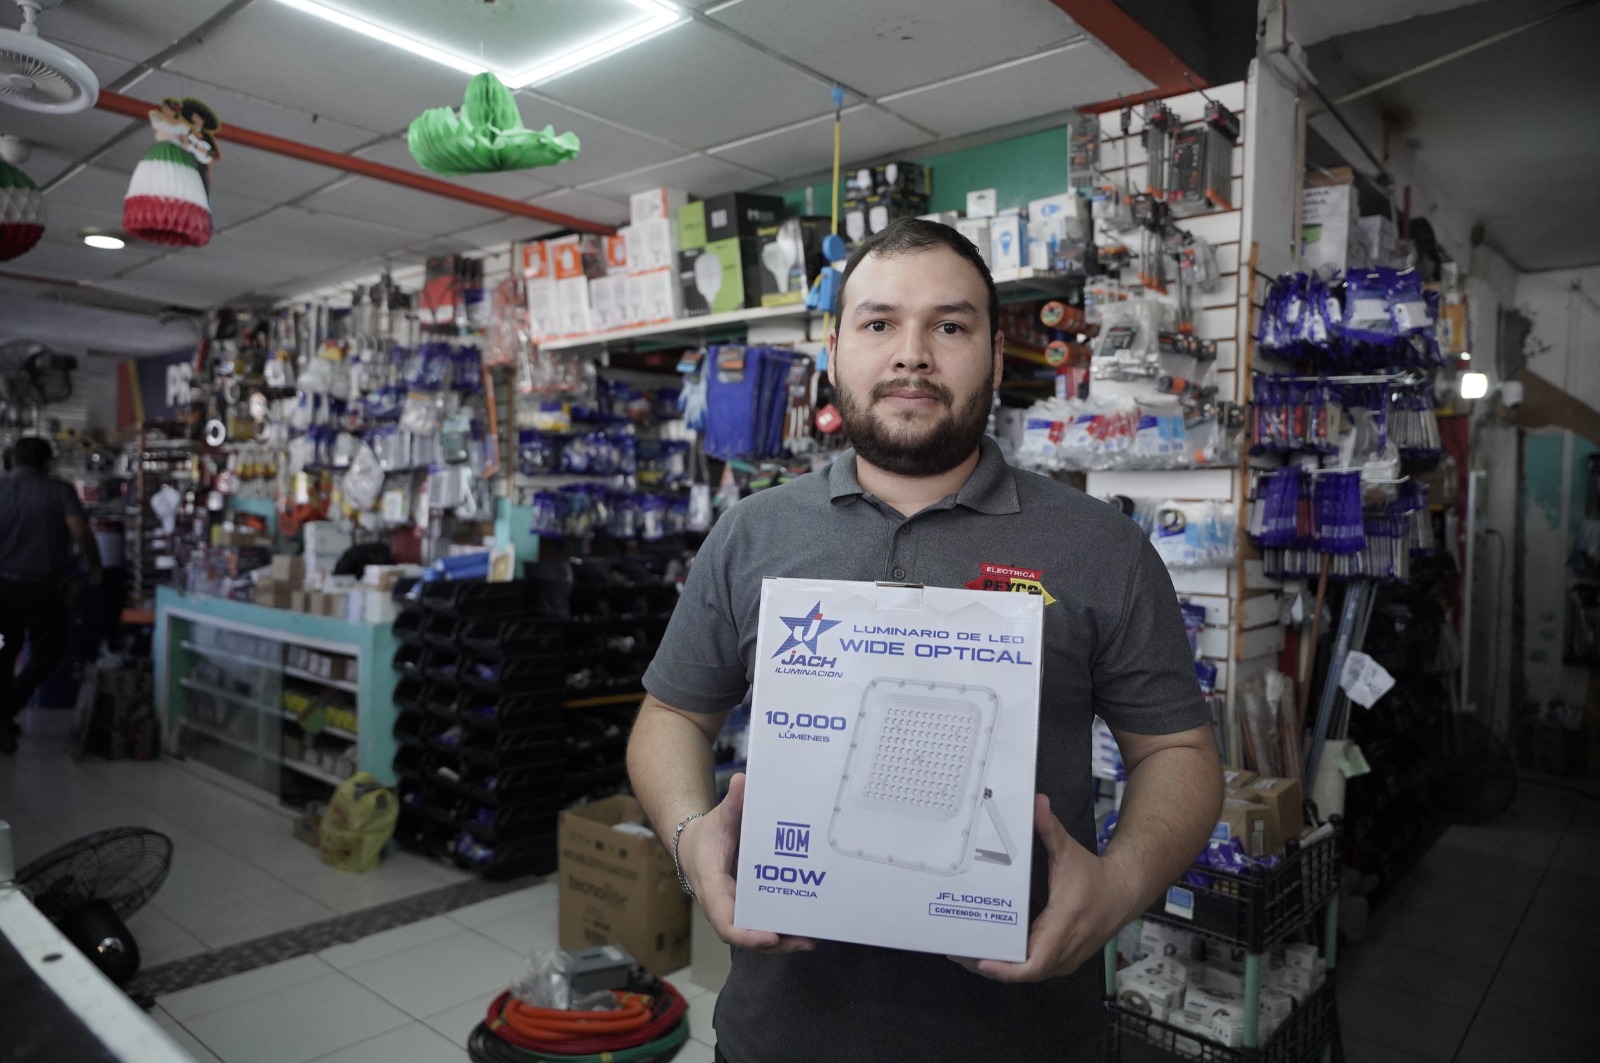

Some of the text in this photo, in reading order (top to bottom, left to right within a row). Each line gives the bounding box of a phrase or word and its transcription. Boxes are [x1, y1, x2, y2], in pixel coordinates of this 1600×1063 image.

[986, 566, 1035, 579] ELECTRICA
[853, 624, 1025, 644] LUMINARIO DE LED
[839, 638, 1032, 665] WIDE OPTICAL
[774, 667, 843, 679] ILUMINACION
[765, 710, 847, 731] 10,000
[778, 729, 830, 743] LÚMENES
[774, 827, 810, 853] NOM
[754, 864, 827, 886] 100W
[758, 884, 818, 899] POTENCIA
[936, 891, 1012, 908] JFL10065N
[934, 906, 982, 918] CONTENIDO:
[990, 912, 1014, 922] PIEZA
